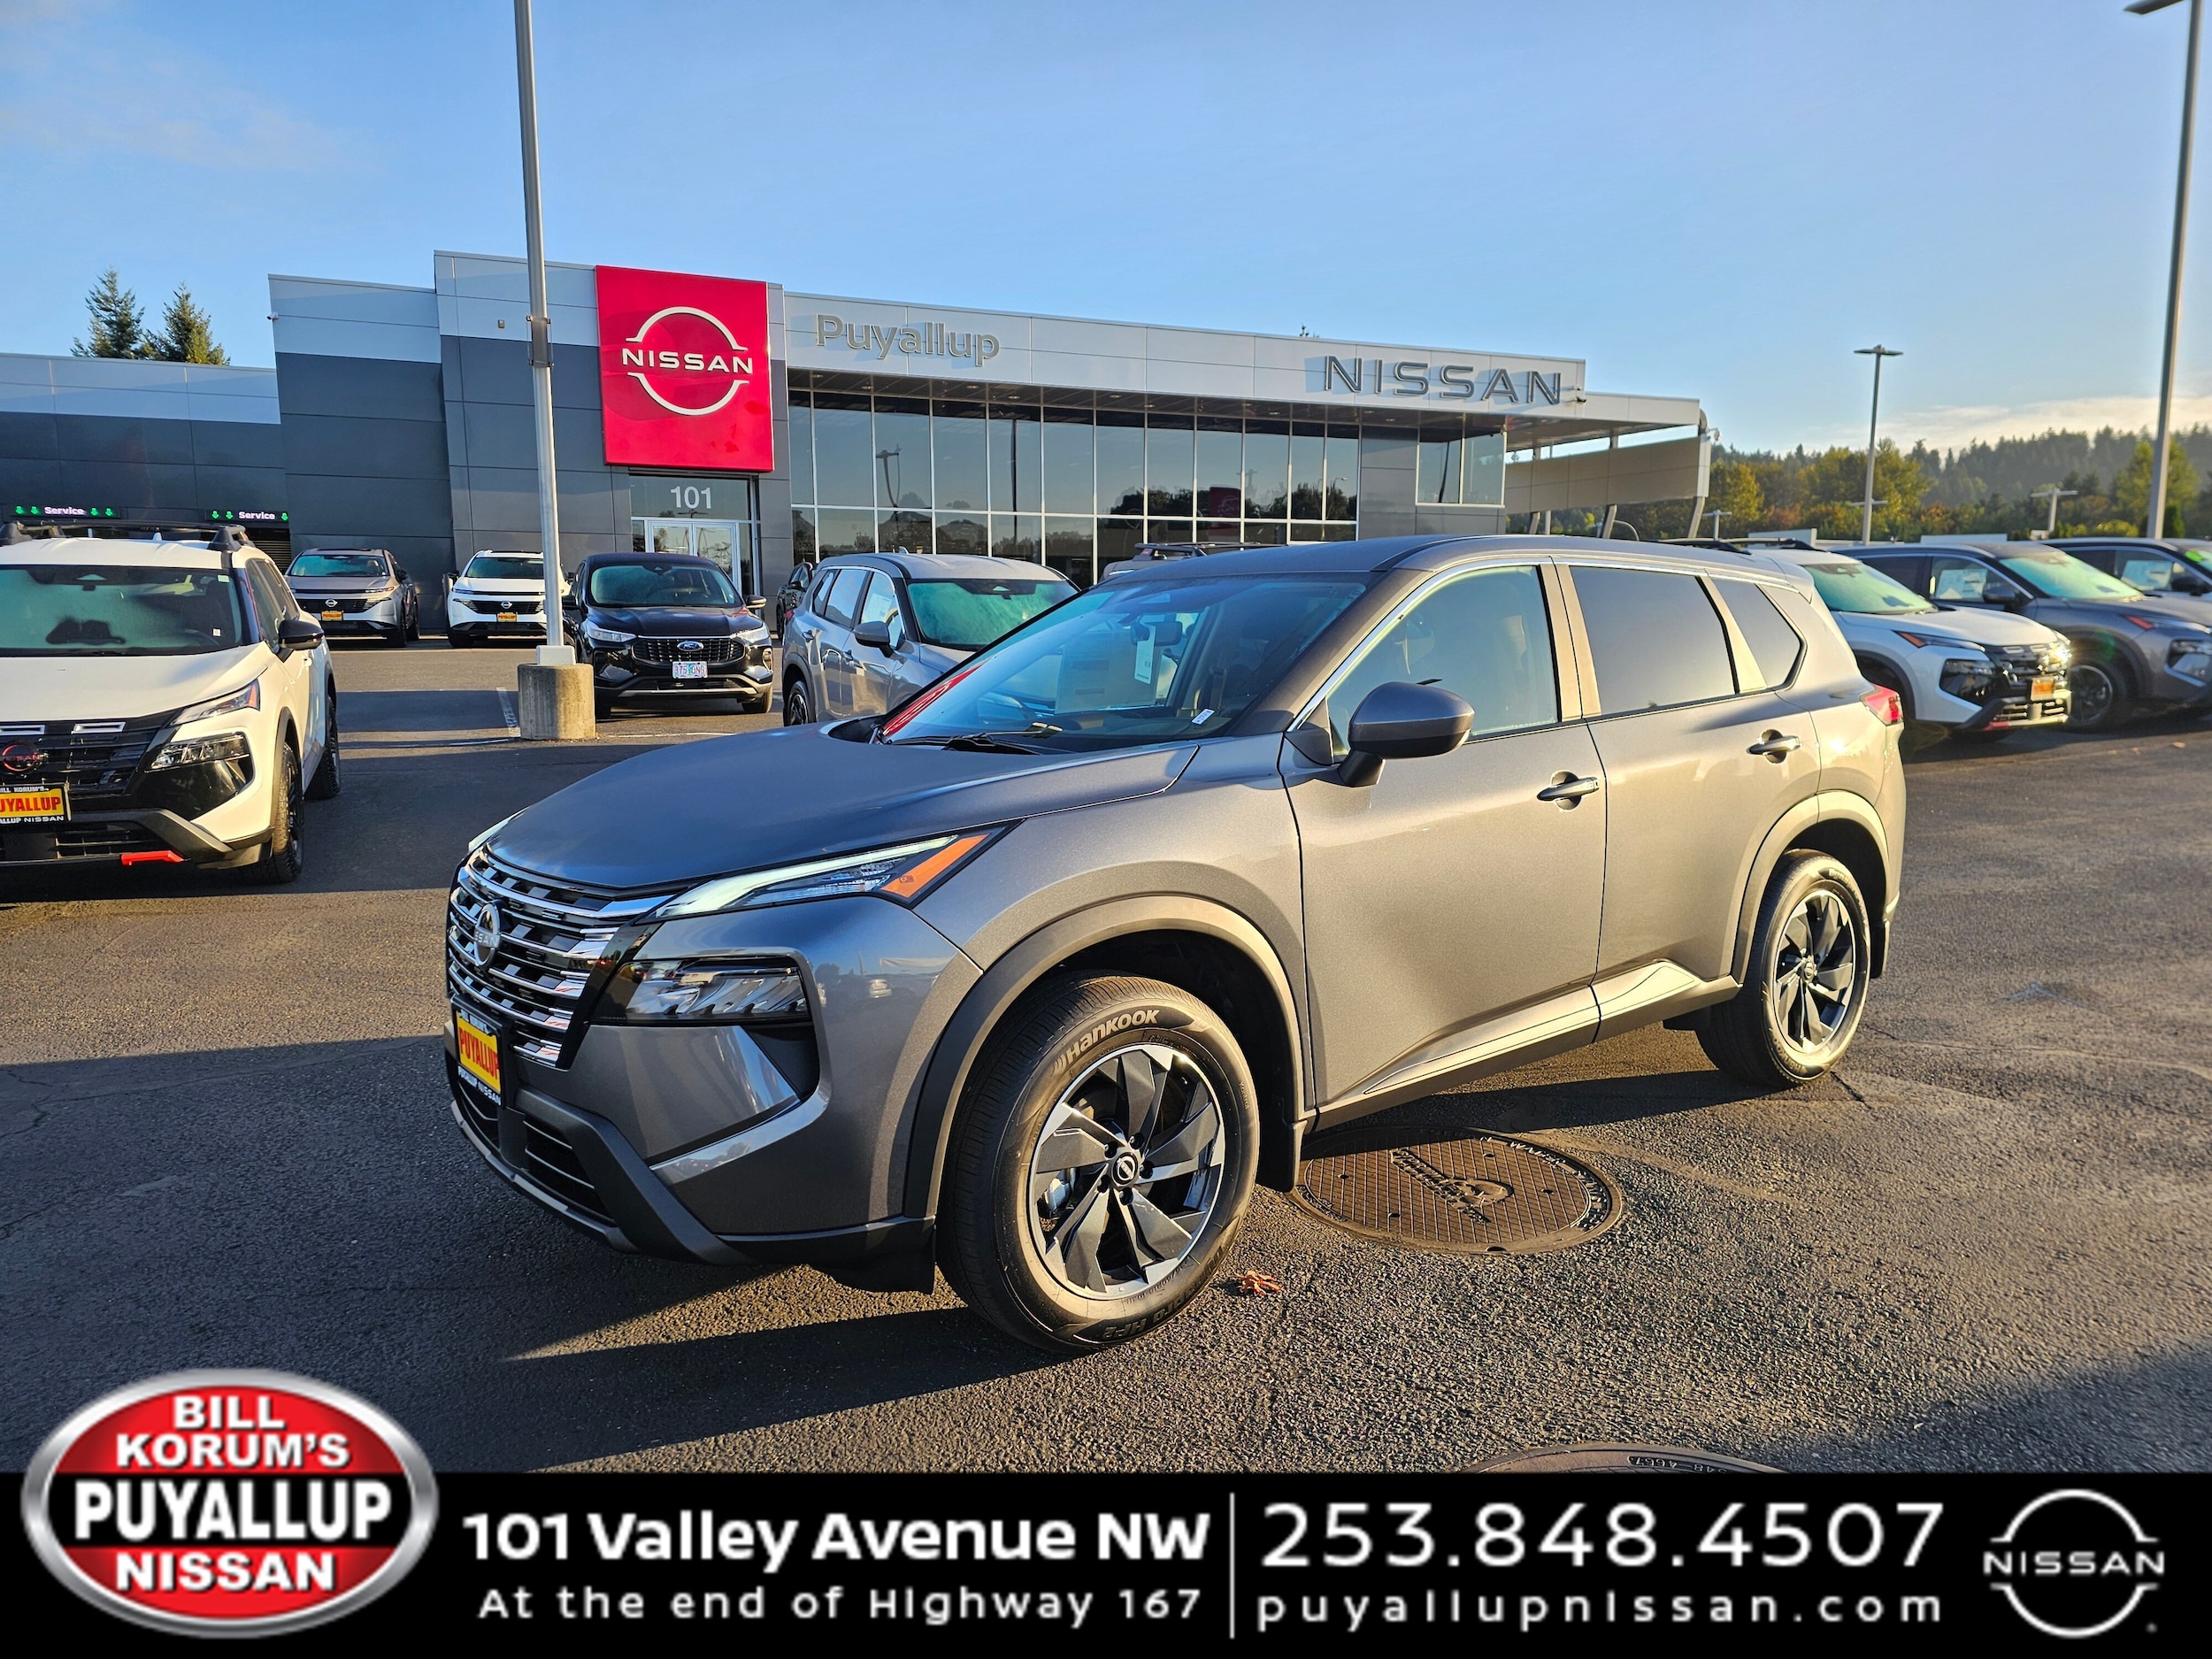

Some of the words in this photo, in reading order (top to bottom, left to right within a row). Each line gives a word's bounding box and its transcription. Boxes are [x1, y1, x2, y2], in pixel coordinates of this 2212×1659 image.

[817, 313, 1001, 367] Puyallup
[622, 348, 753, 374] NISSAN
[1325, 355, 1562, 405] NISSAN
[670, 486, 711, 510] 101
[44, 506, 85, 516] Service
[238, 511, 275, 520] Service
